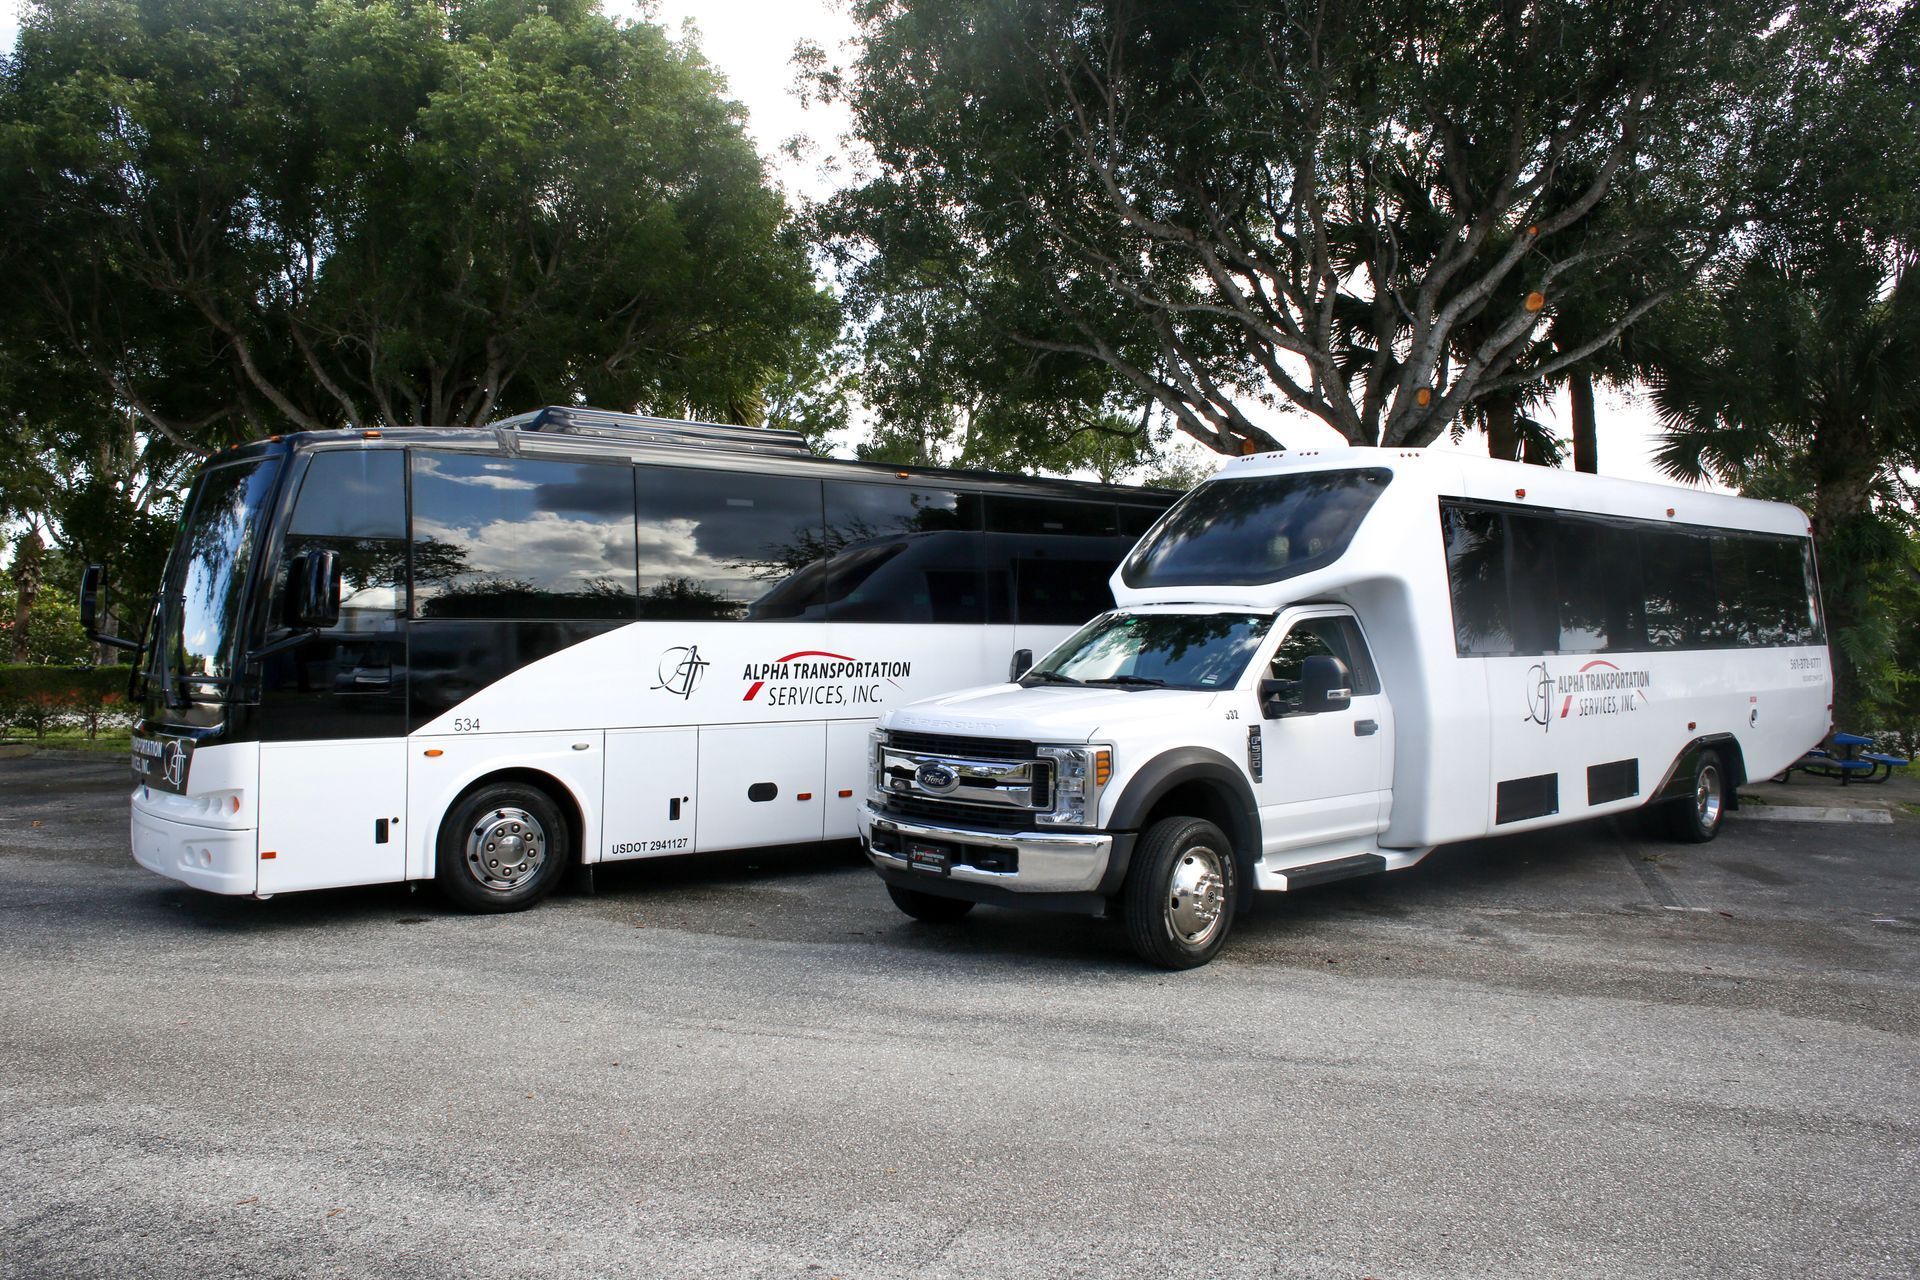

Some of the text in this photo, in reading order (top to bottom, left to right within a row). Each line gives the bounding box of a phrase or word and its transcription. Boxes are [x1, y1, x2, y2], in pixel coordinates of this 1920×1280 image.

[743, 661, 911, 681] ALPHA TRANSPORTATION
[1558, 670, 1650, 693] ALPHA TRANSPORTATION
[768, 684, 883, 706] SERVICES, INC.
[1579, 694, 1637, 716] SERVICES, INC.
[454, 718, 480, 731] 534
[924, 773, 946, 785] Ford
[612, 838, 688, 854] USDOT 2941127
